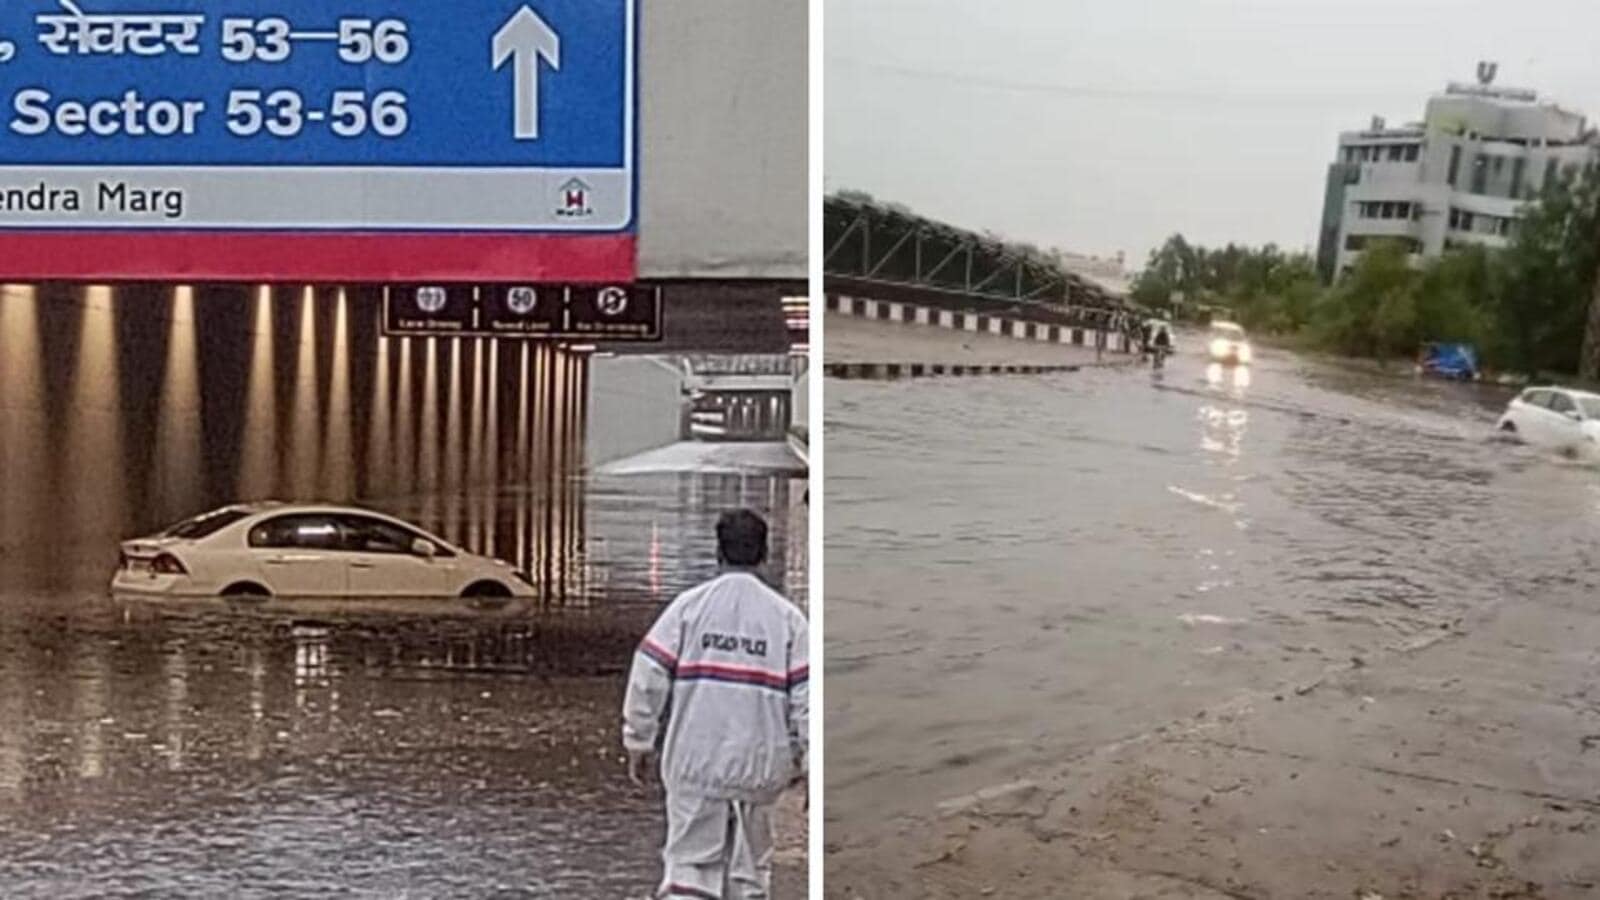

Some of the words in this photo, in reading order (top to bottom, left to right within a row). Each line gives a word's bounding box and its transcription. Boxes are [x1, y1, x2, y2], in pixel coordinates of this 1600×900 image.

[10, 89, 204, 136] Sector
[226, 90, 409, 137] 53-56
[0, 181, 79, 211] ndra
[98, 182, 183, 218] Marg
